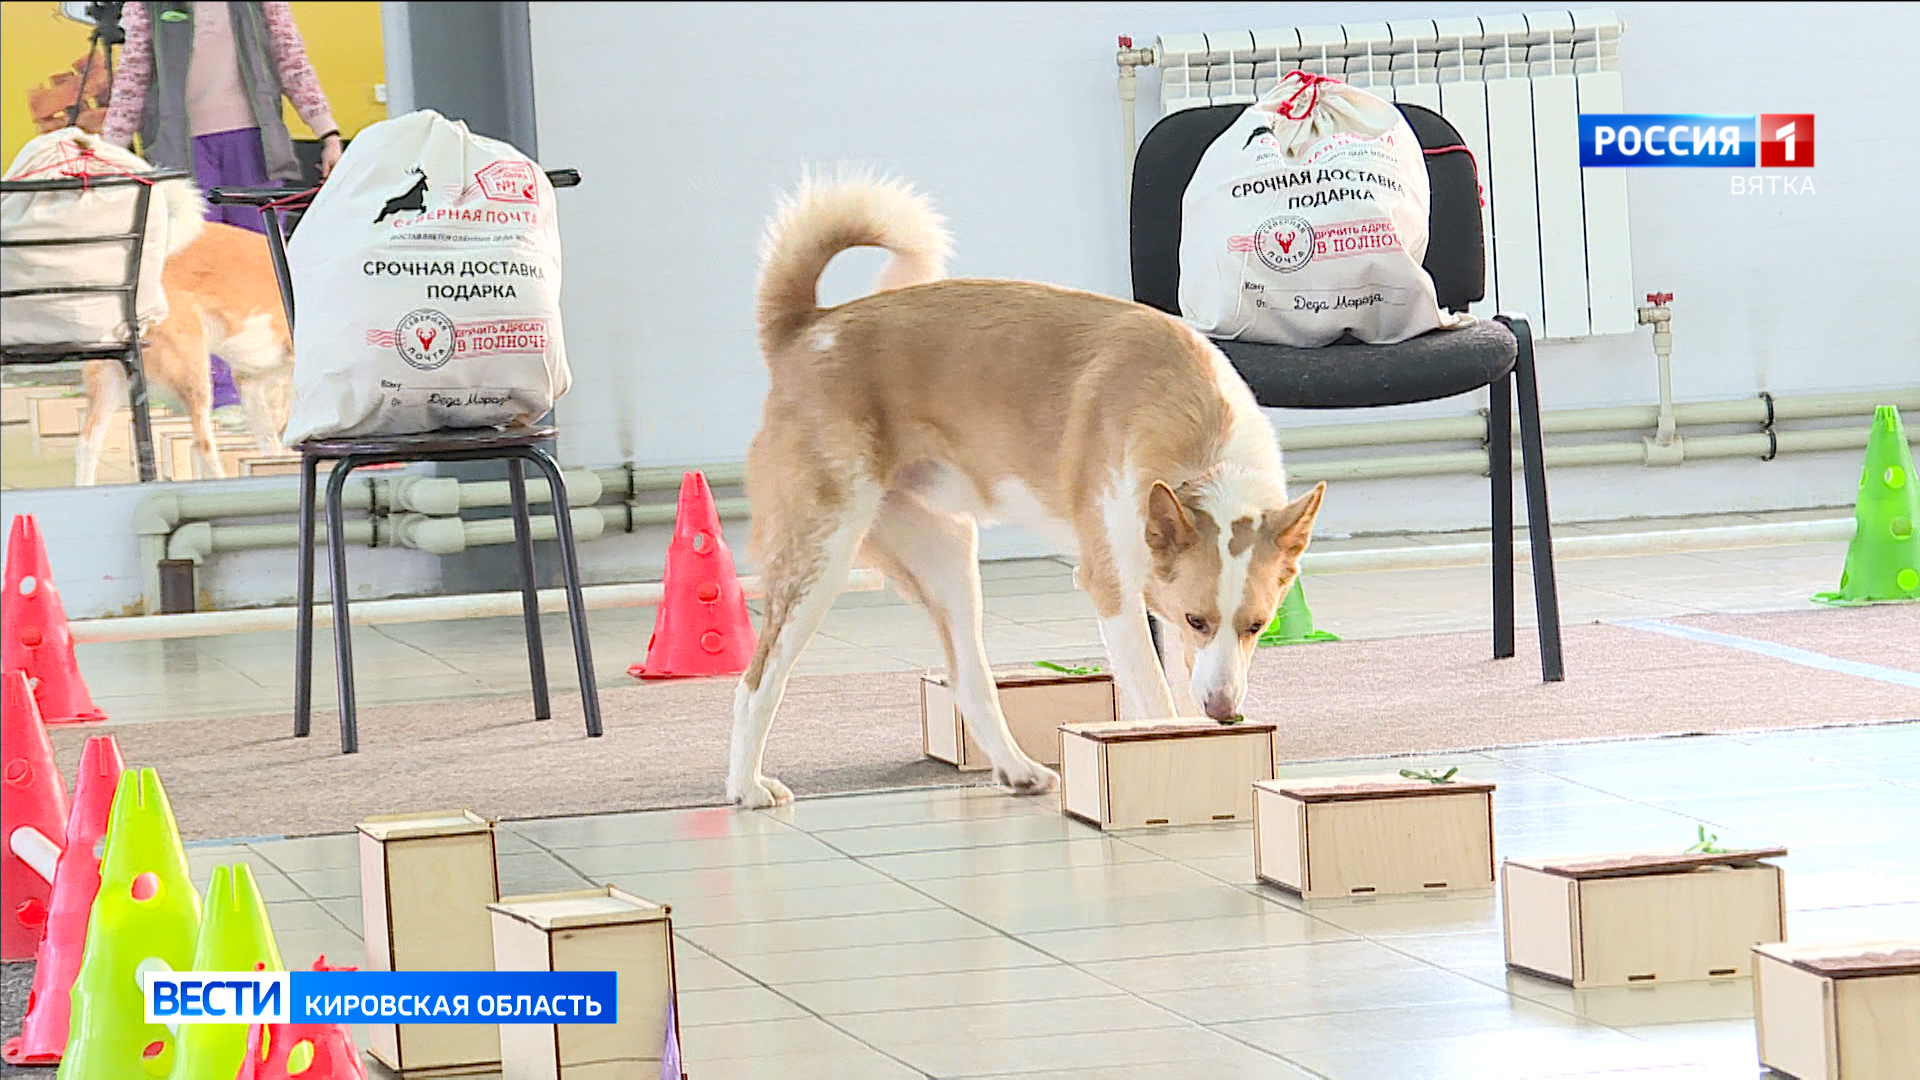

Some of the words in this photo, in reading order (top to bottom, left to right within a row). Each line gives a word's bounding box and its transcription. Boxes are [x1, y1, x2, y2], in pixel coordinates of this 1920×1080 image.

[1231, 169, 1311, 198] СРОЧНАЯ
[1316, 168, 1406, 198] ДОСТАВКА
[1288, 188, 1376, 210] ПОДАРКА
[1361, 223, 1394, 234] АДРЕС
[1317, 241, 1327, 254] В
[363, 260, 455, 277] СРОЧНАЯ
[460, 260, 546, 281] ДОСТАВКА
[427, 284, 517, 301] ПОДАРКА
